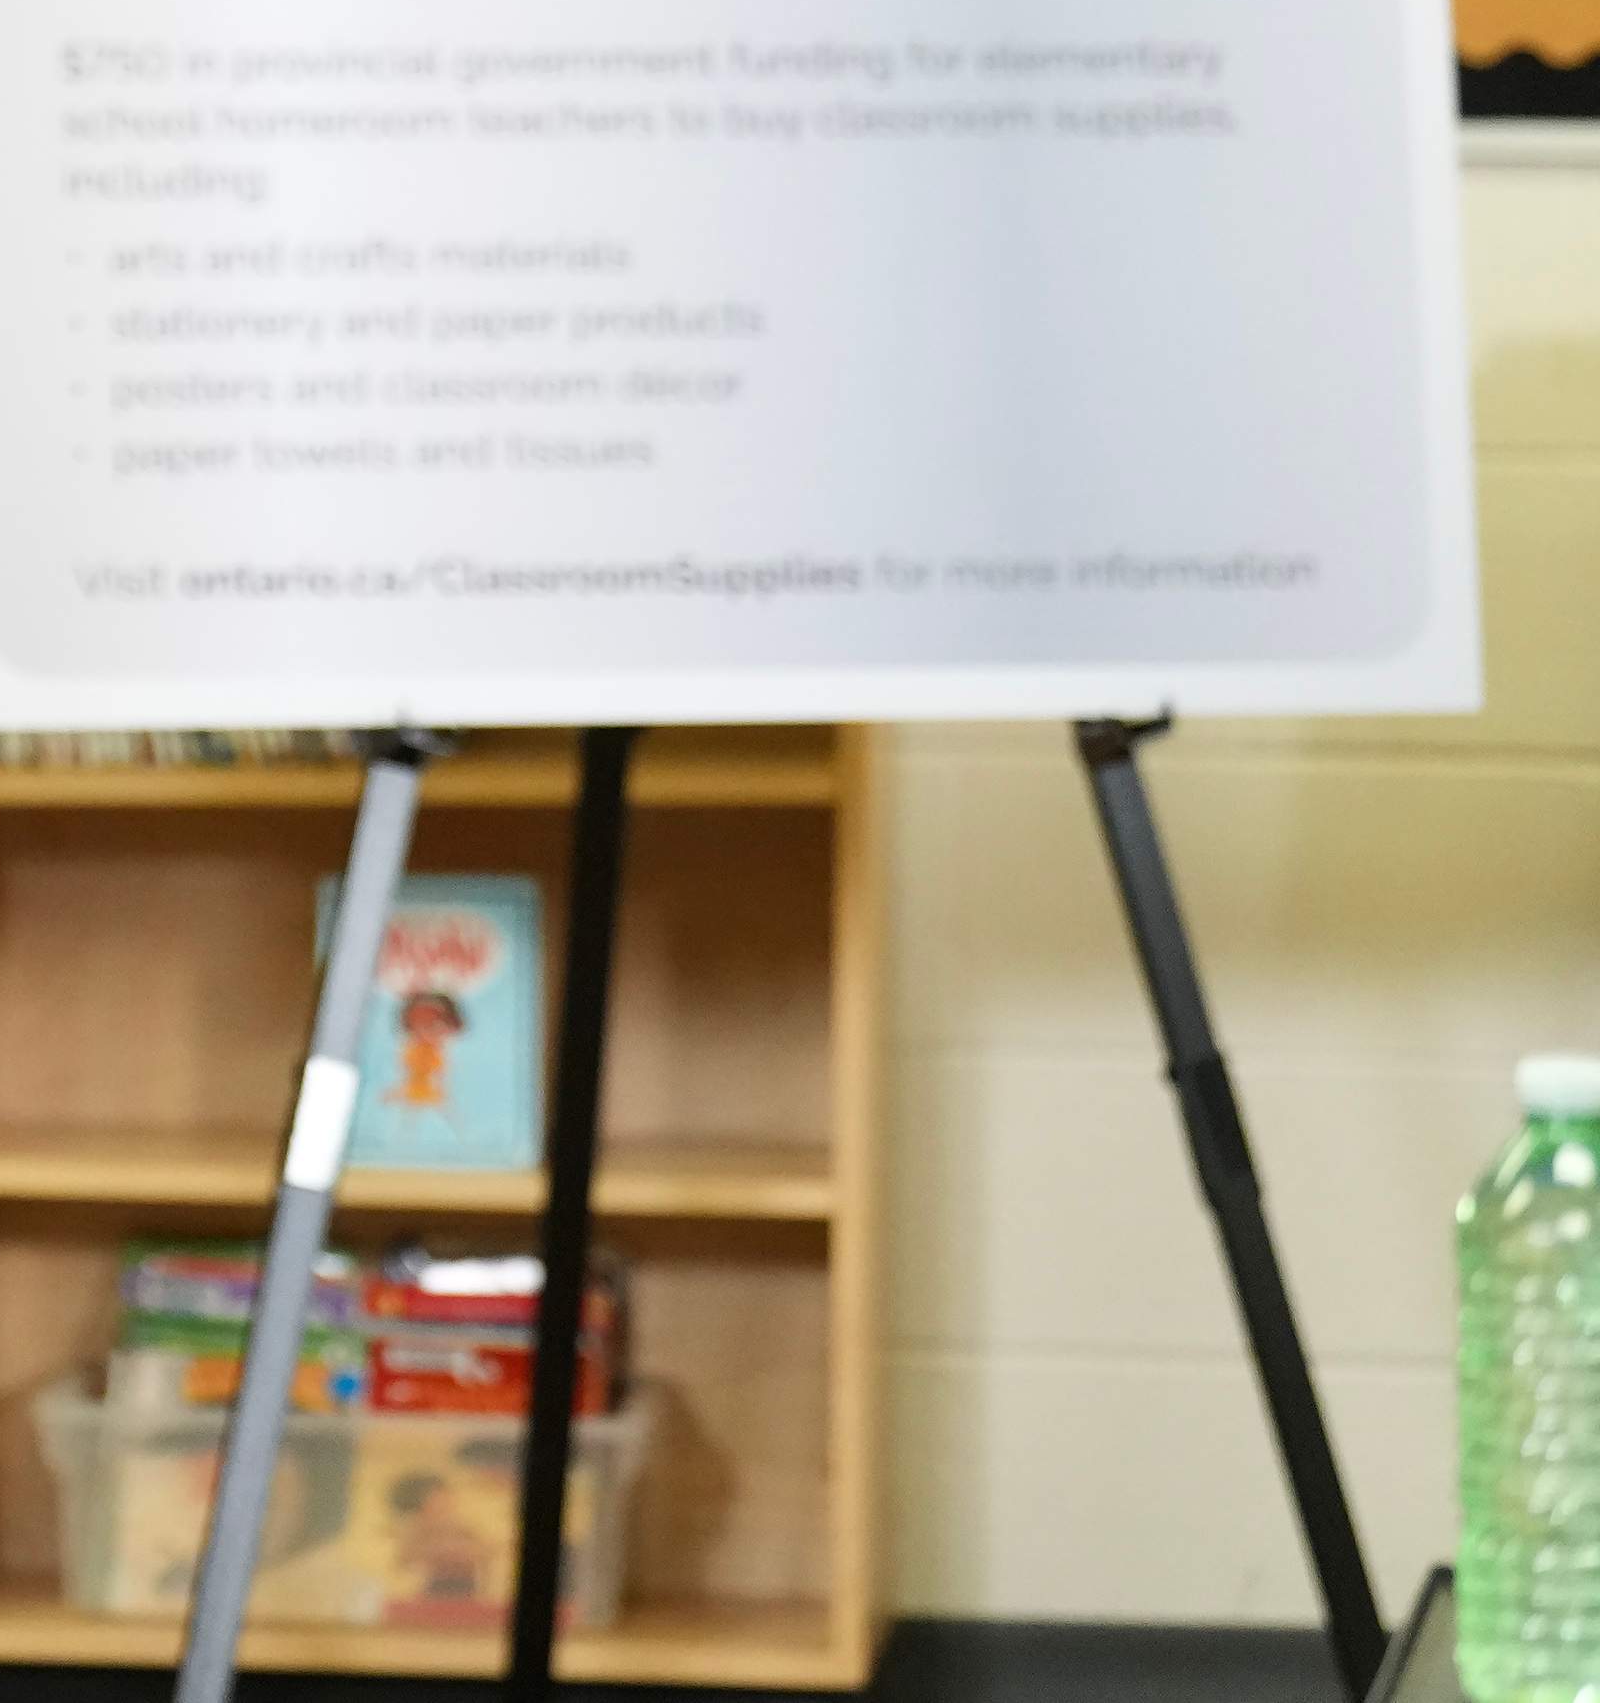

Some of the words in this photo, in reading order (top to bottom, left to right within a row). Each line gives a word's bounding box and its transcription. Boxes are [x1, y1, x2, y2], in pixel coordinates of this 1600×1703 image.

[61, 41, 173, 86] $750
[184, 43, 218, 81] in
[228, 39, 441, 89] provincial
[455, 43, 714, 92] government
[726, 37, 895, 89] funding
[904, 37, 966, 81] for
[972, 37, 1224, 87] elementary
[60, 99, 204, 142] school
[204, 99, 456, 142] homeroom
[464, 101, 661, 141] teachers
[666, 101, 711, 139] to
[718, 97, 802, 149] buy
[809, 97, 1037, 139] classroom
[105, 237, 187, 277] arts
[200, 235, 289, 277] and
[295, 233, 417, 277] crafts
[424, 233, 634, 279] materials
[106, 301, 327, 349] stationery
[338, 301, 424, 341] and
[428, 307, 559, 349] paper
[566, 299, 770, 349] products
[106, 367, 276, 413] posters
[288, 365, 372, 405] and
[378, 365, 606, 407] classroom
[108, 439, 242, 481] paper
[248, 433, 402, 473] towels
[410, 431, 497, 473] and
[500, 431, 656, 473] tissues
[74, 553, 166, 601] Visit
[872, 549, 934, 593] for
[942, 555, 1060, 593] more
[1068, 545, 1320, 593] information
